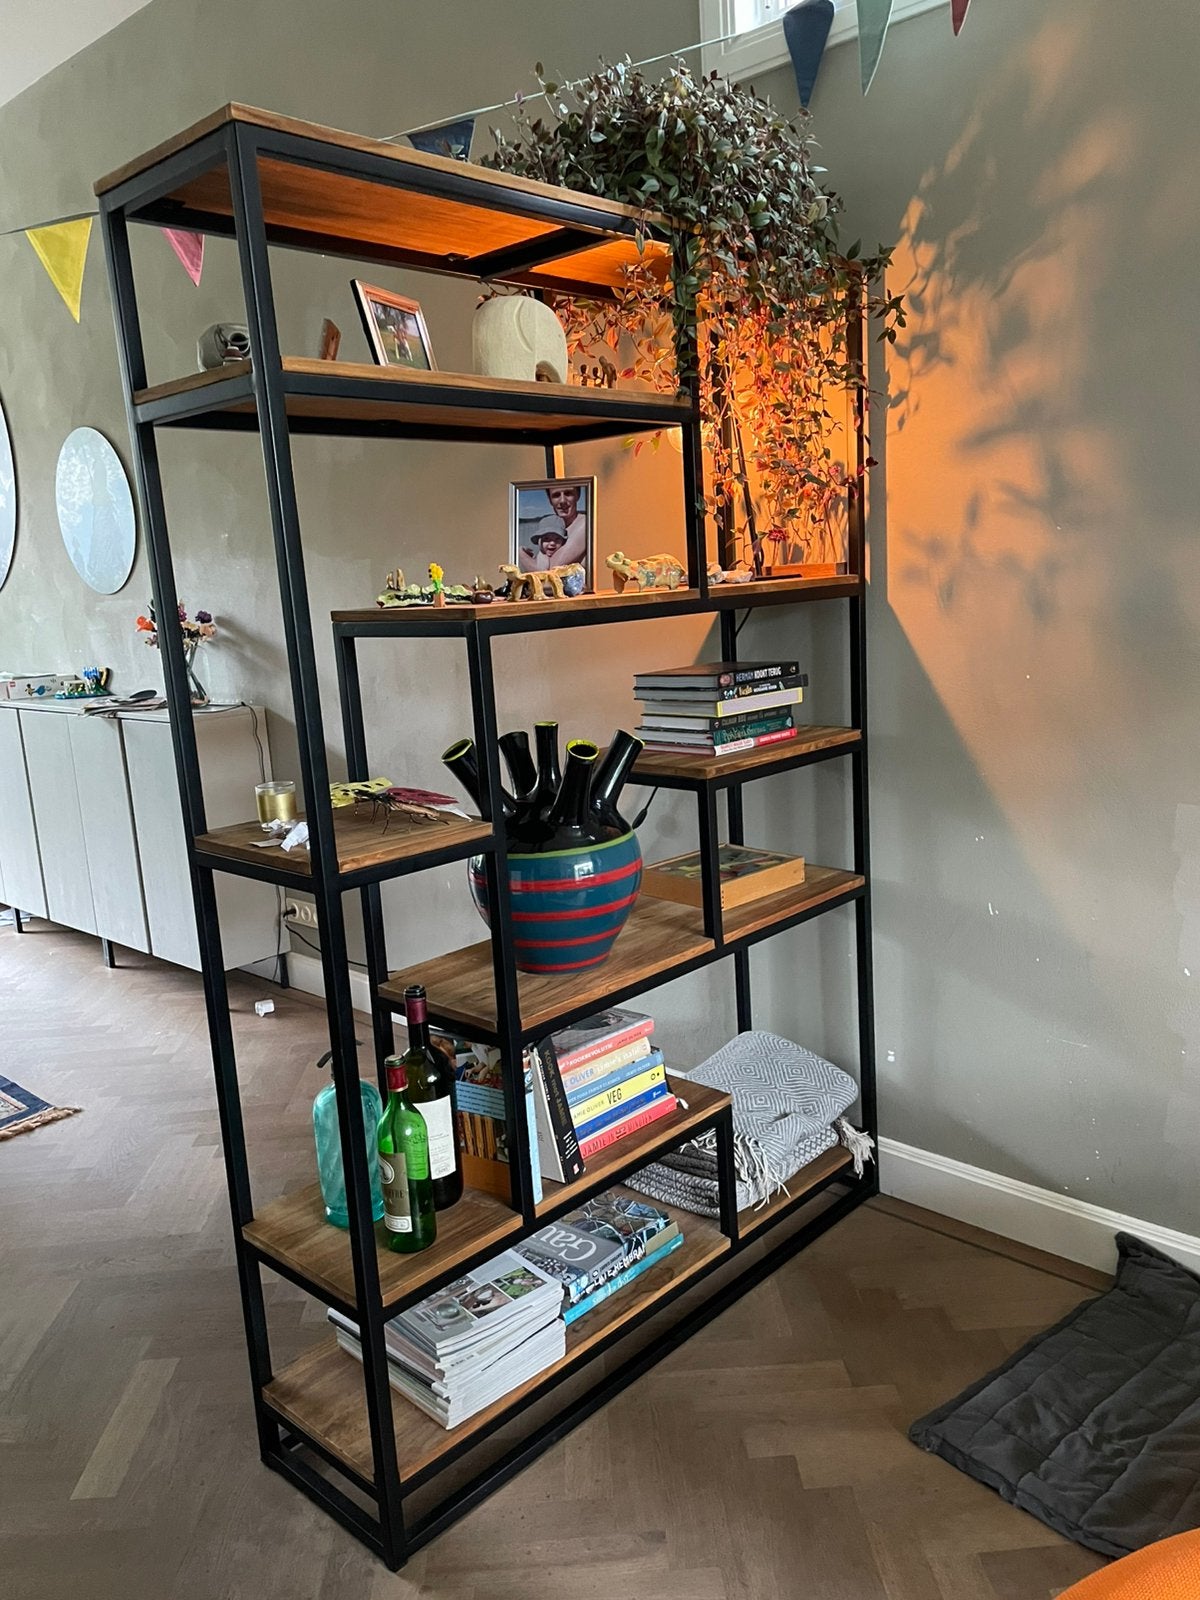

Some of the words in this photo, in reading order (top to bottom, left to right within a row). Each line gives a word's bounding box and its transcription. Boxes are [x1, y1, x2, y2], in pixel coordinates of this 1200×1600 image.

[570, 1068, 594, 1085] OLIVER
[573, 1108, 586, 1119] AMIE
[606, 1088, 622, 1105] VEG
